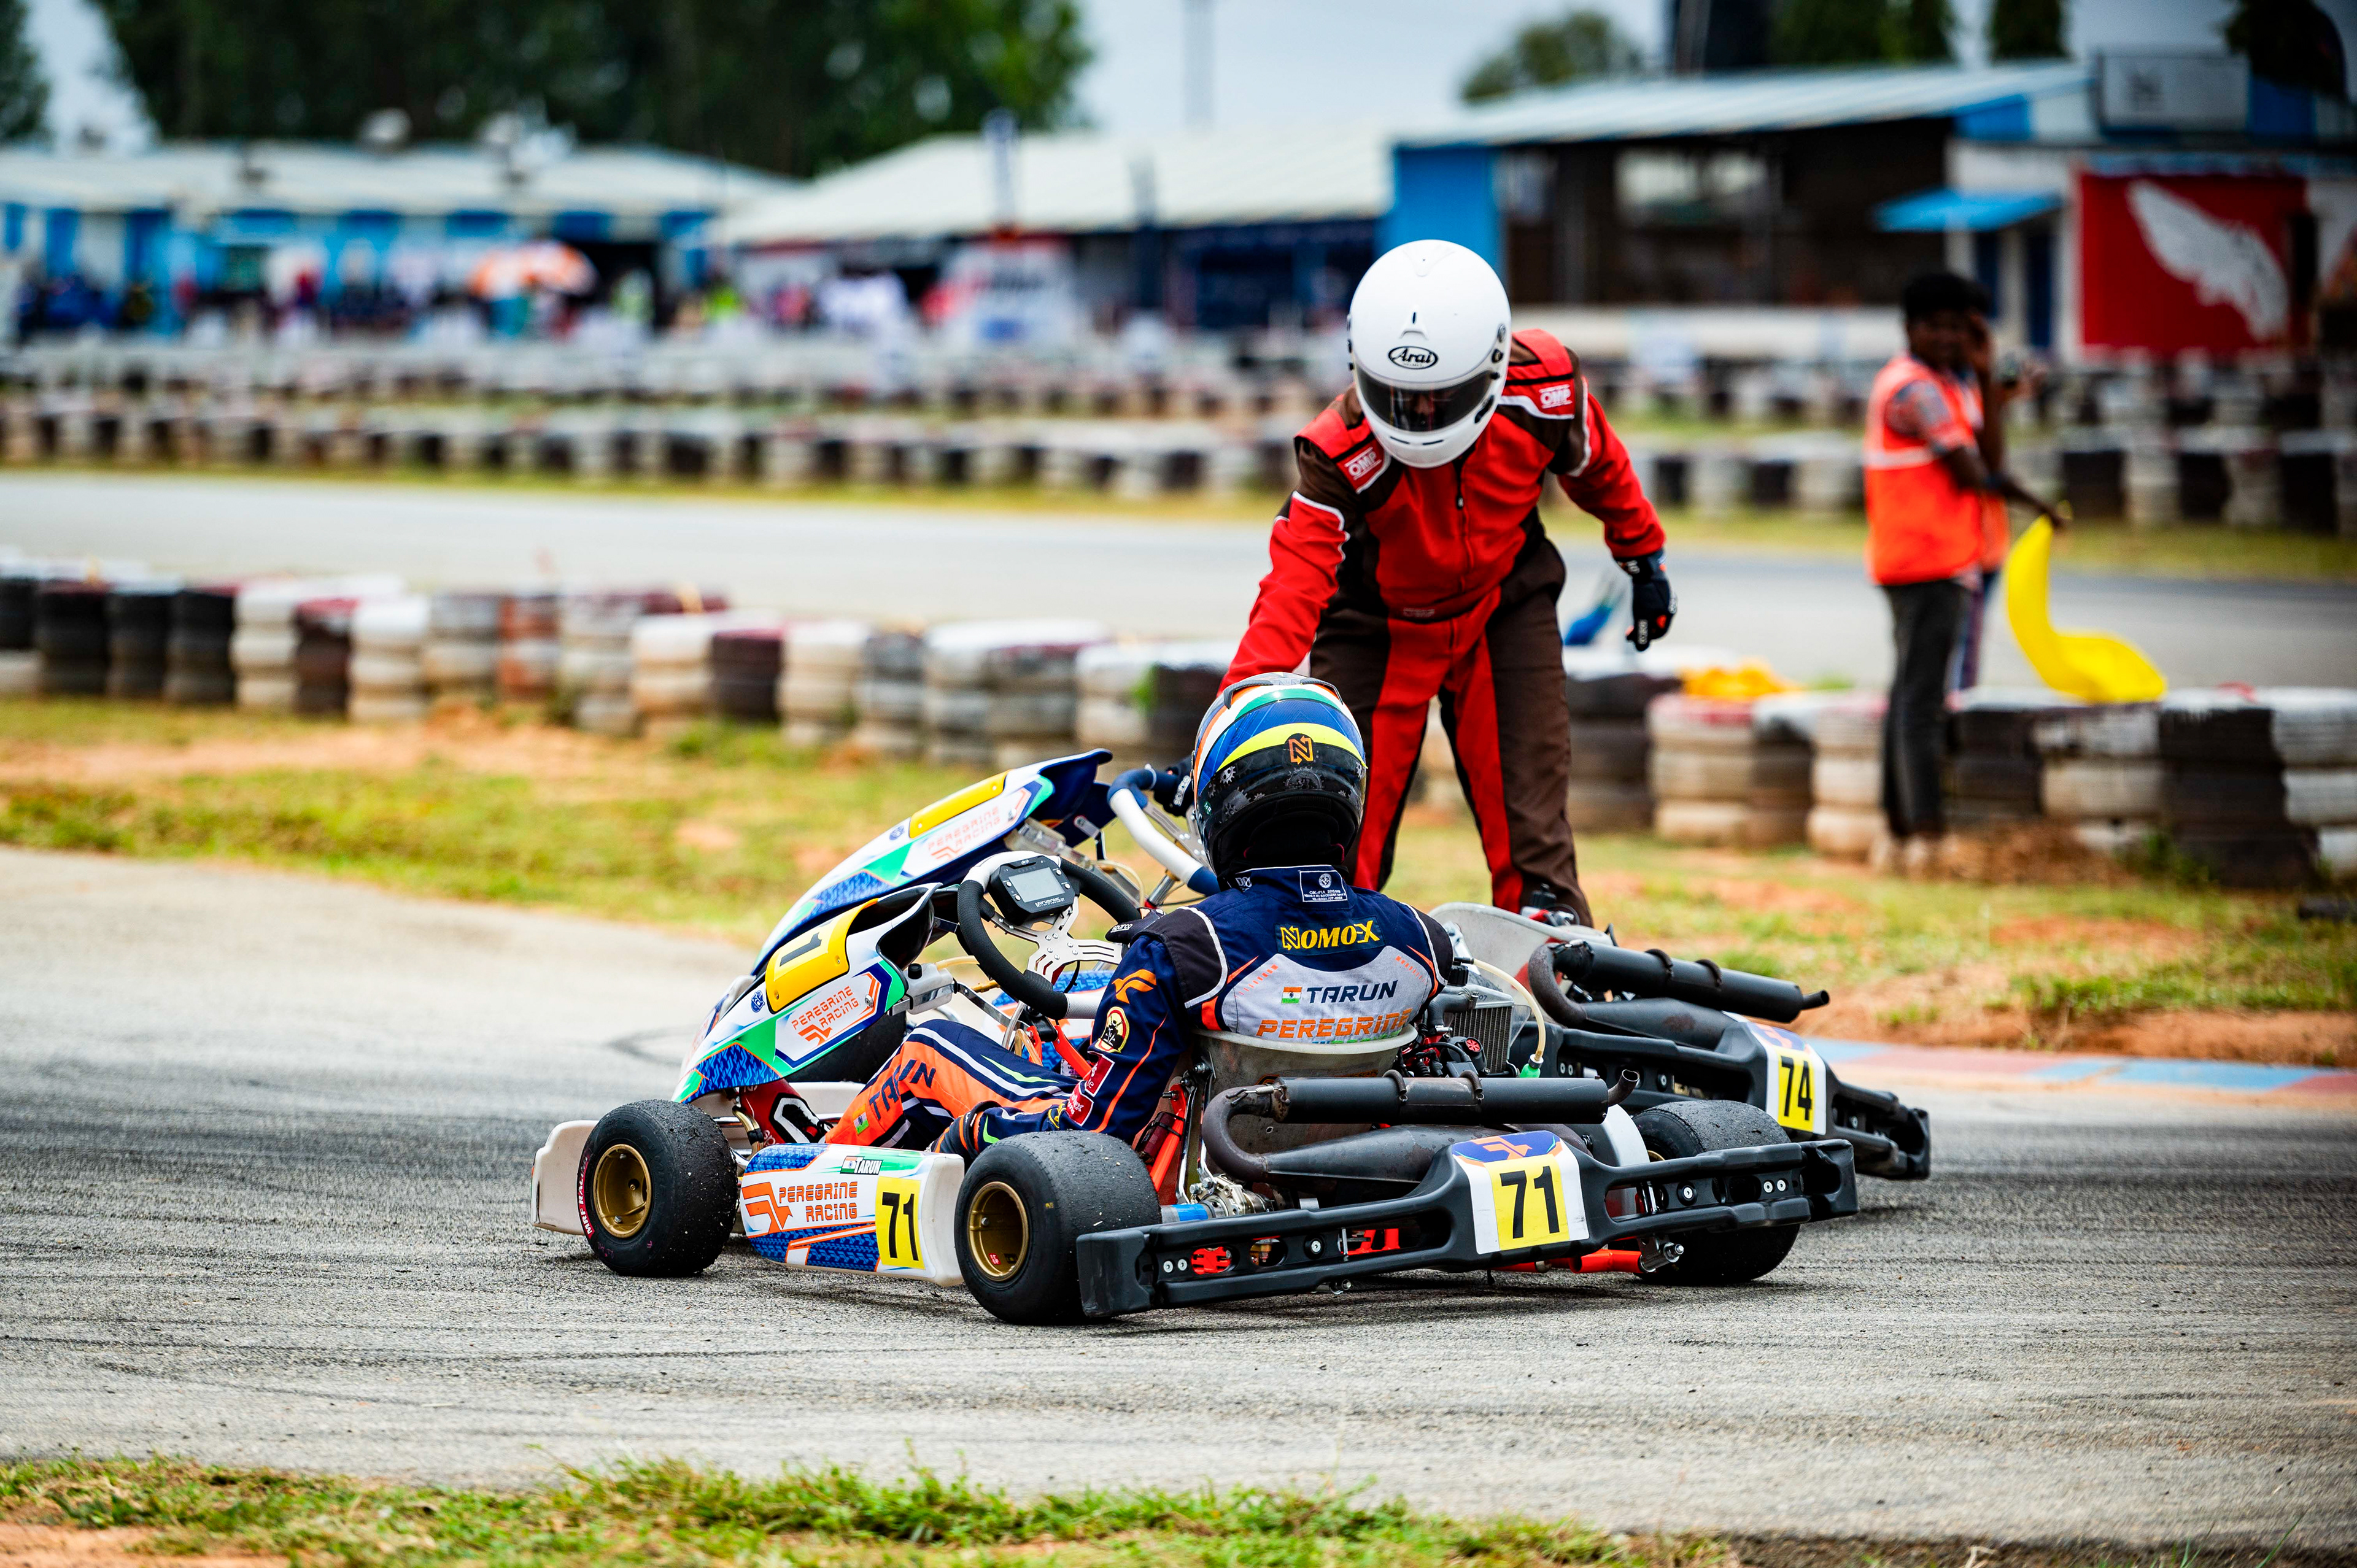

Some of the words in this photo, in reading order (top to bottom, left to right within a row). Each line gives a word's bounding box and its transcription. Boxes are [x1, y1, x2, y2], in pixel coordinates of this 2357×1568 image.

[1390, 347, 1432, 363] Arai
[1539, 387, 1571, 405] OMP
[1349, 451, 1377, 477] OMP
[927, 806, 999, 850] PEREGRINE
[955, 817, 1000, 848] RACING
[1306, 979, 1399, 1004] TARUN
[791, 986, 854, 1030] PEREGRINE
[819, 997, 859, 1029] RACING
[1256, 1008, 1413, 1038] PEREGRINE
[1781, 1055, 1813, 1121] 74
[853, 1156, 883, 1175] TARUN
[779, 1181, 858, 1204] PEREGRINE
[1499, 1165, 1560, 1239] 71
[579, 1208, 593, 1235] MRF
[805, 1202, 858, 1222] RACING
[881, 1191, 919, 1262] 71
